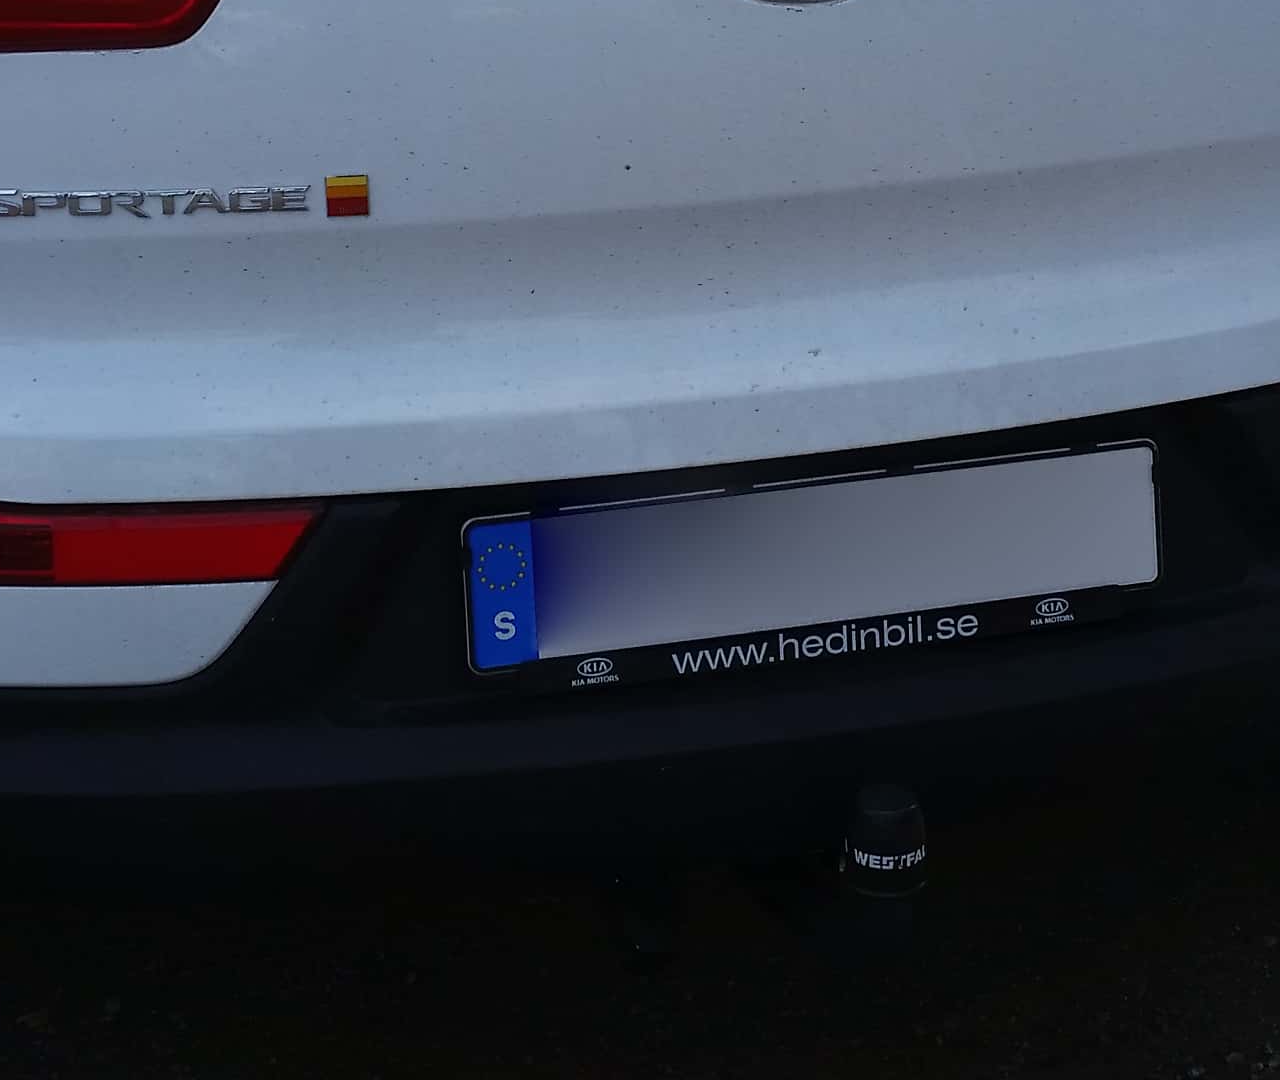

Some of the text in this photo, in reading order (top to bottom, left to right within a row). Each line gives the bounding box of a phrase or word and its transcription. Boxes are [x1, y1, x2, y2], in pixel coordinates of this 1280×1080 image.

[1041, 601, 1064, 613] KIA
[494, 610, 516, 641] S
[671, 615, 979, 674] www.hedinbil.se
[583, 661, 608, 674] KIA
